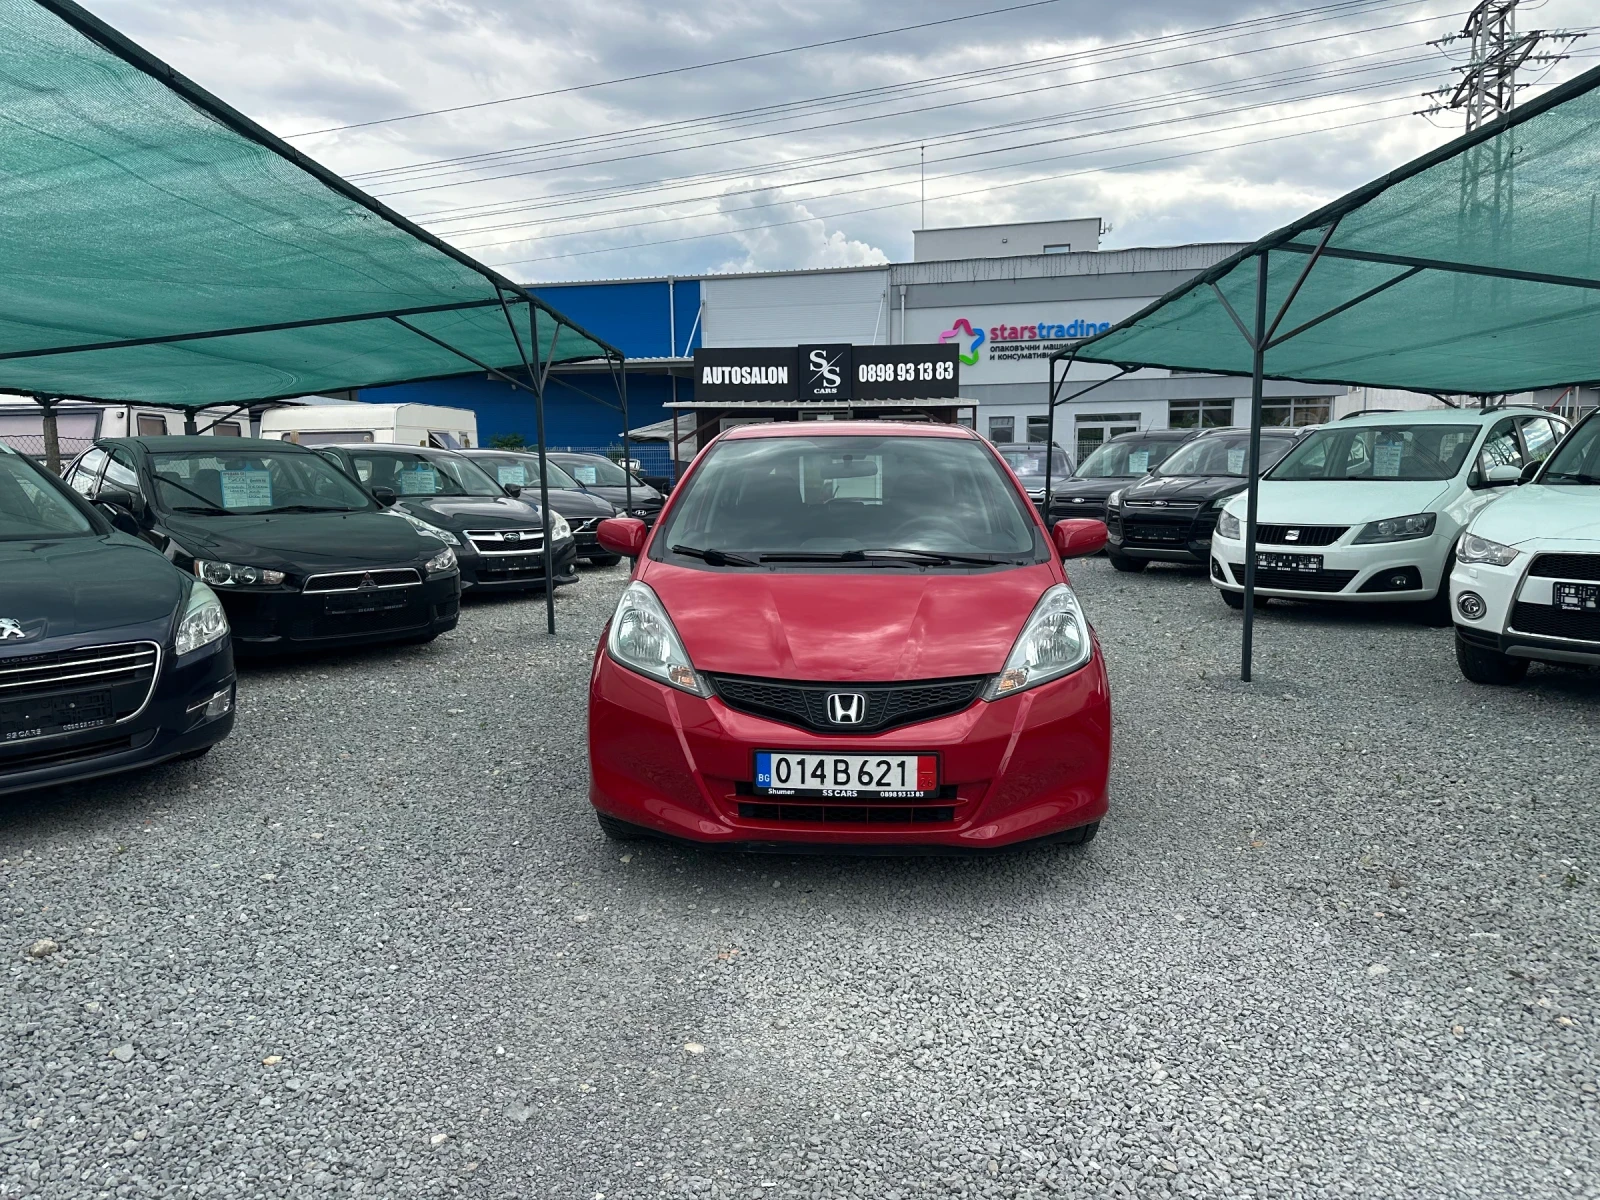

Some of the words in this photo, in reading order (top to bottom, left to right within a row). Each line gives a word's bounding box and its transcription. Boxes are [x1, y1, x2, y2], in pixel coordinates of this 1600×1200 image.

[702, 366, 788, 385] AUTOSALON
[858, 363, 895, 383] 0898
[897, 362, 915, 381] 93
[917, 362, 933, 381] 13
[935, 361, 954, 380] 83
[758, 773, 770, 782] BG
